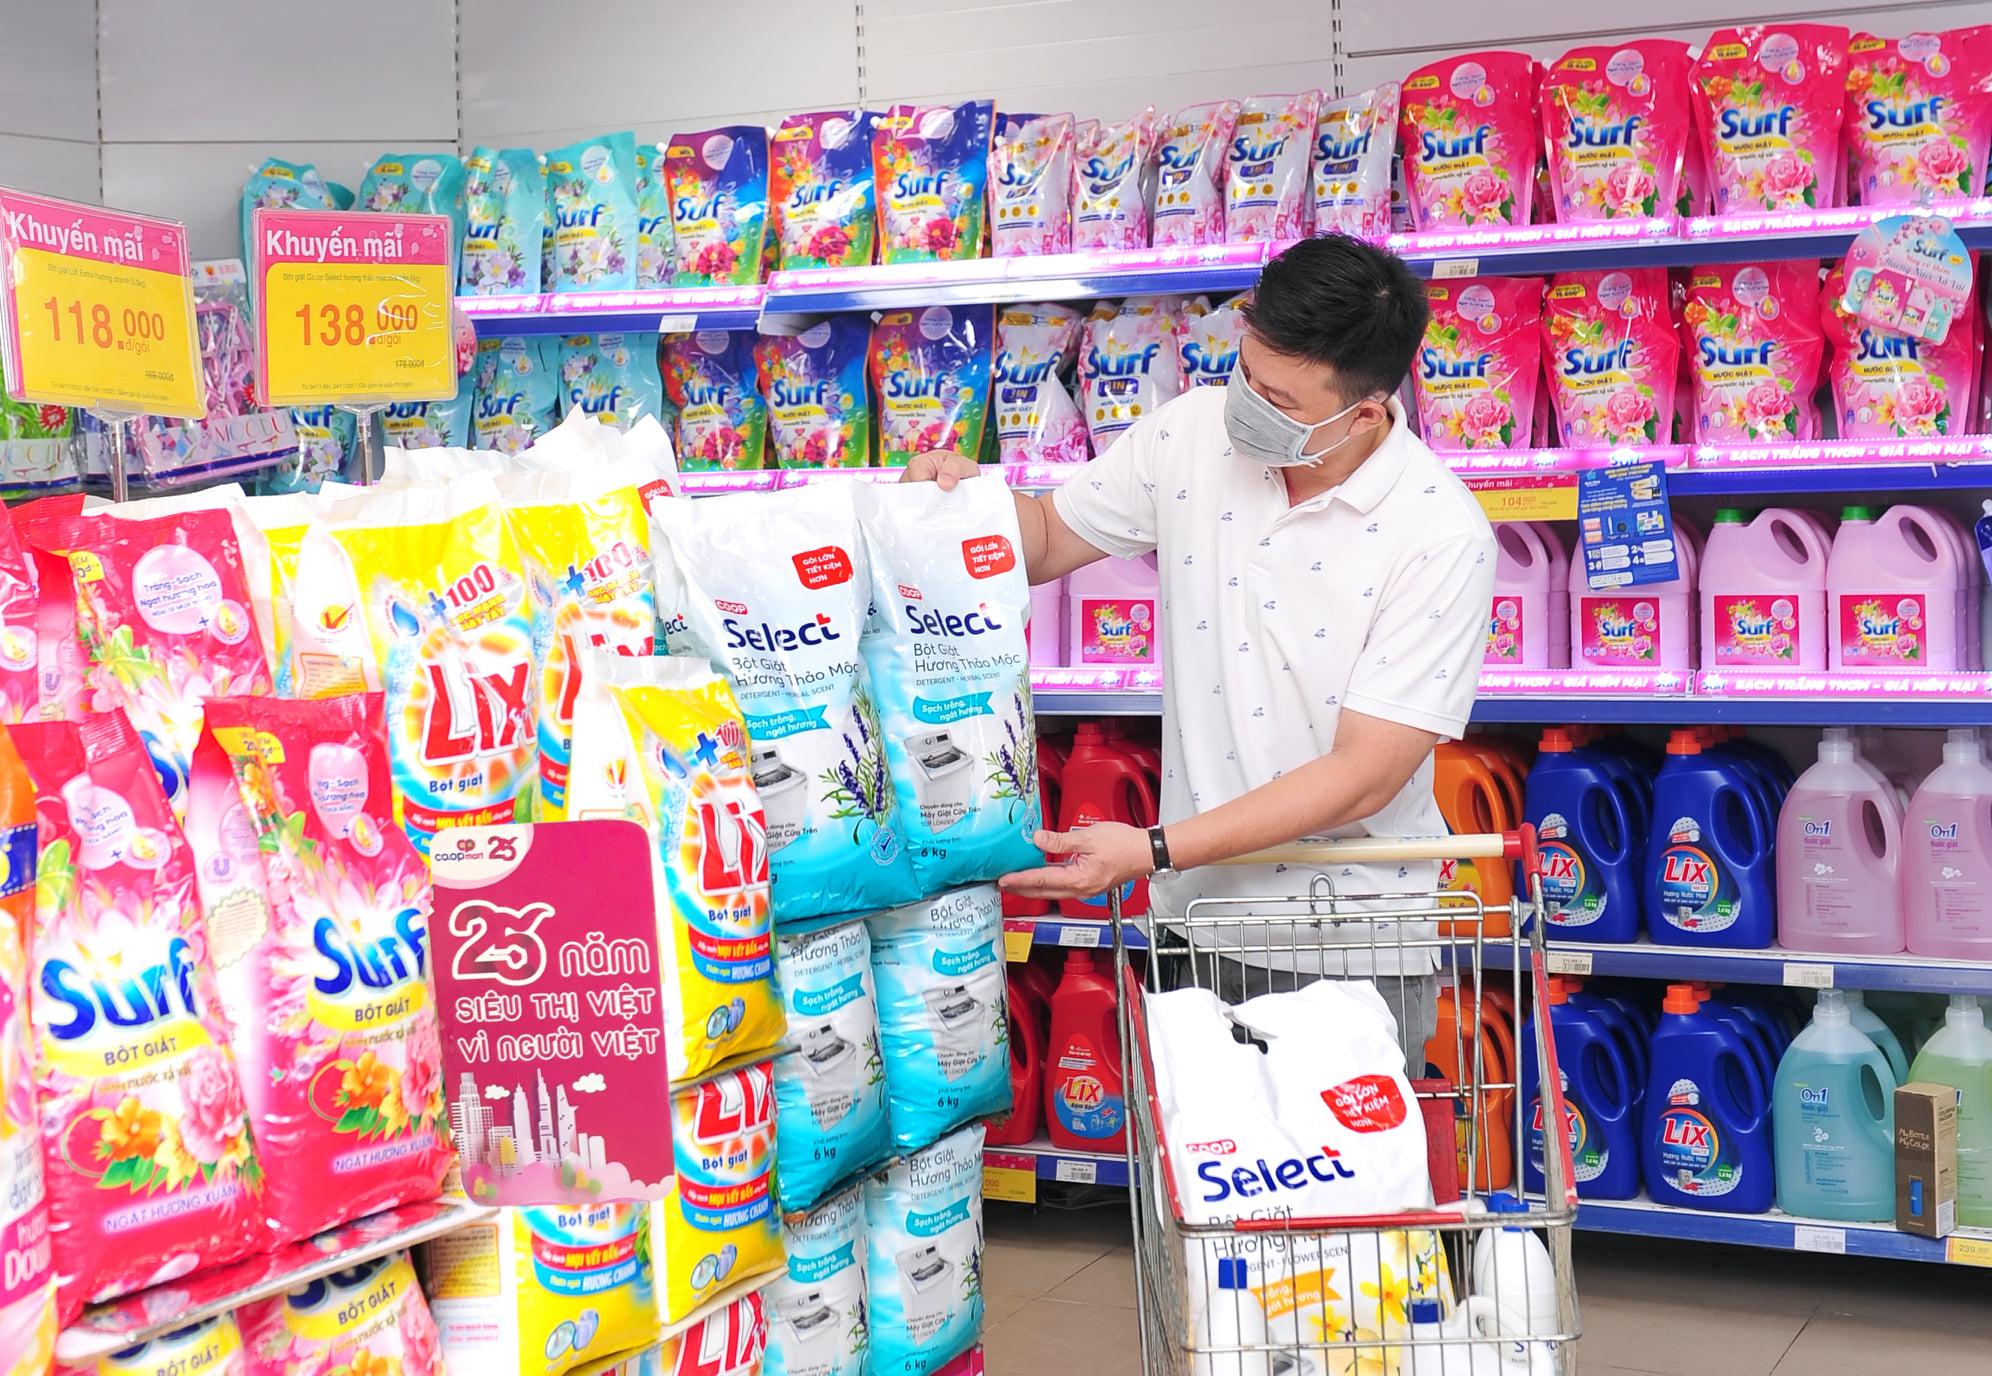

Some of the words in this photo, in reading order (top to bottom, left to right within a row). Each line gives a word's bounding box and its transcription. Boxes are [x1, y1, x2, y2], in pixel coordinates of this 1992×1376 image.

[1720, 105, 1796, 139] Surf
[1866, 96, 1945, 130] Surf
[1229, 127, 1293, 162] Surf
[1314, 124, 1376, 161] Surf
[1421, 125, 1491, 162] Surf
[1567, 115, 1642, 149] Surf
[791, 179, 844, 209] Surf
[894, 170, 949, 199] Surf
[555, 203, 606, 228] Surf
[676, 192, 728, 222] Surf
[9, 211, 97, 254] Khuyến
[103, 232, 144, 261] mãi
[266, 226, 357, 263] Khuyến
[363, 231, 403, 258] mãi
[1913, 238, 1950, 262] Surf
[1085, 342, 1159, 379] Surf
[1422, 347, 1494, 380] Surf
[1564, 339, 1636, 377] Surf
[1700, 335, 1777, 368] Surf
[683, 385, 732, 407] Surf
[774, 379, 828, 407] Surf
[886, 370, 950, 398] Surf
[478, 392, 523, 419] Surf
[1466, 478, 1494, 491] huyến
[714, 600, 748, 615] COOP
[905, 602, 1003, 637] Select
[722, 612, 841, 652] Select
[1101, 621, 1133, 637] Surf
[1601, 620, 1637, 638] Surf
[1737, 619, 1775, 636] Surf
[1863, 619, 1900, 636] Surf
[913, 643, 938, 657] Bột
[937, 643, 960, 657] Giặt
[914, 659, 960, 674] Hương
[961, 658, 991, 671] Thảo
[991, 652, 1021, 668] Mộc
[732, 657, 759, 672] Bột
[760, 657, 787, 673] Giặt
[735, 674, 785, 689] Hương
[786, 668, 826, 687] Thảo
[828, 661, 860, 679] Mộc
[916, 677, 955, 687] DETERGENT
[959, 674, 983, 683] HERBAL
[982, 671, 1001, 681] SCENT
[740, 690, 781, 701] DETERGENT
[811, 683, 836, 696] SCENT
[921, 703, 942, 715] Sạch
[939, 709, 959, 722] ngát
[959, 704, 984, 718] hương
[745, 718, 768, 730] Sạch
[765, 723, 788, 738] ngát
[787, 718, 818, 734] hương
[920, 811, 937, 821] Máy
[936, 808, 952, 818] Giặt
[920, 847, 929, 859] 6
[931, 847, 947, 860] kg
[1663, 855, 1710, 884] Lix
[314, 907, 428, 996] Surf
[559, 932, 650, 978] năm
[40, 937, 201, 1041] Surf
[354, 1002, 384, 1024] BỘT
[455, 990, 523, 1024] SIÊU
[530, 992, 579, 1024] THỊ
[585, 983, 656, 1022] VIỆT
[103, 1045, 139, 1068] BỘT
[457, 1028, 490, 1064] VÌ
[497, 1025, 584, 1060] NGƯỜI
[590, 1024, 660, 1061] VIỆT
[1063, 1076, 1102, 1104] Lix
[1662, 1117, 1710, 1148] Lix
[334, 1153, 369, 1173] NGÁT
[369, 1144, 407, 1164] HƯƠNG
[909, 1156, 933, 1174] Bột
[933, 1148, 956, 1167] Giặt
[908, 1166, 952, 1189] Hương
[951, 1157, 974, 1176] Thảo
[1197, 1145, 1356, 1202] Select
[105, 1207, 149, 1235] NGÁT
[150, 1195, 202, 1225] HƯƠNG
[337, 1302, 367, 1327] BỘT
[904, 1359, 913, 1372] 6
[914, 1357, 928, 1373] kg
